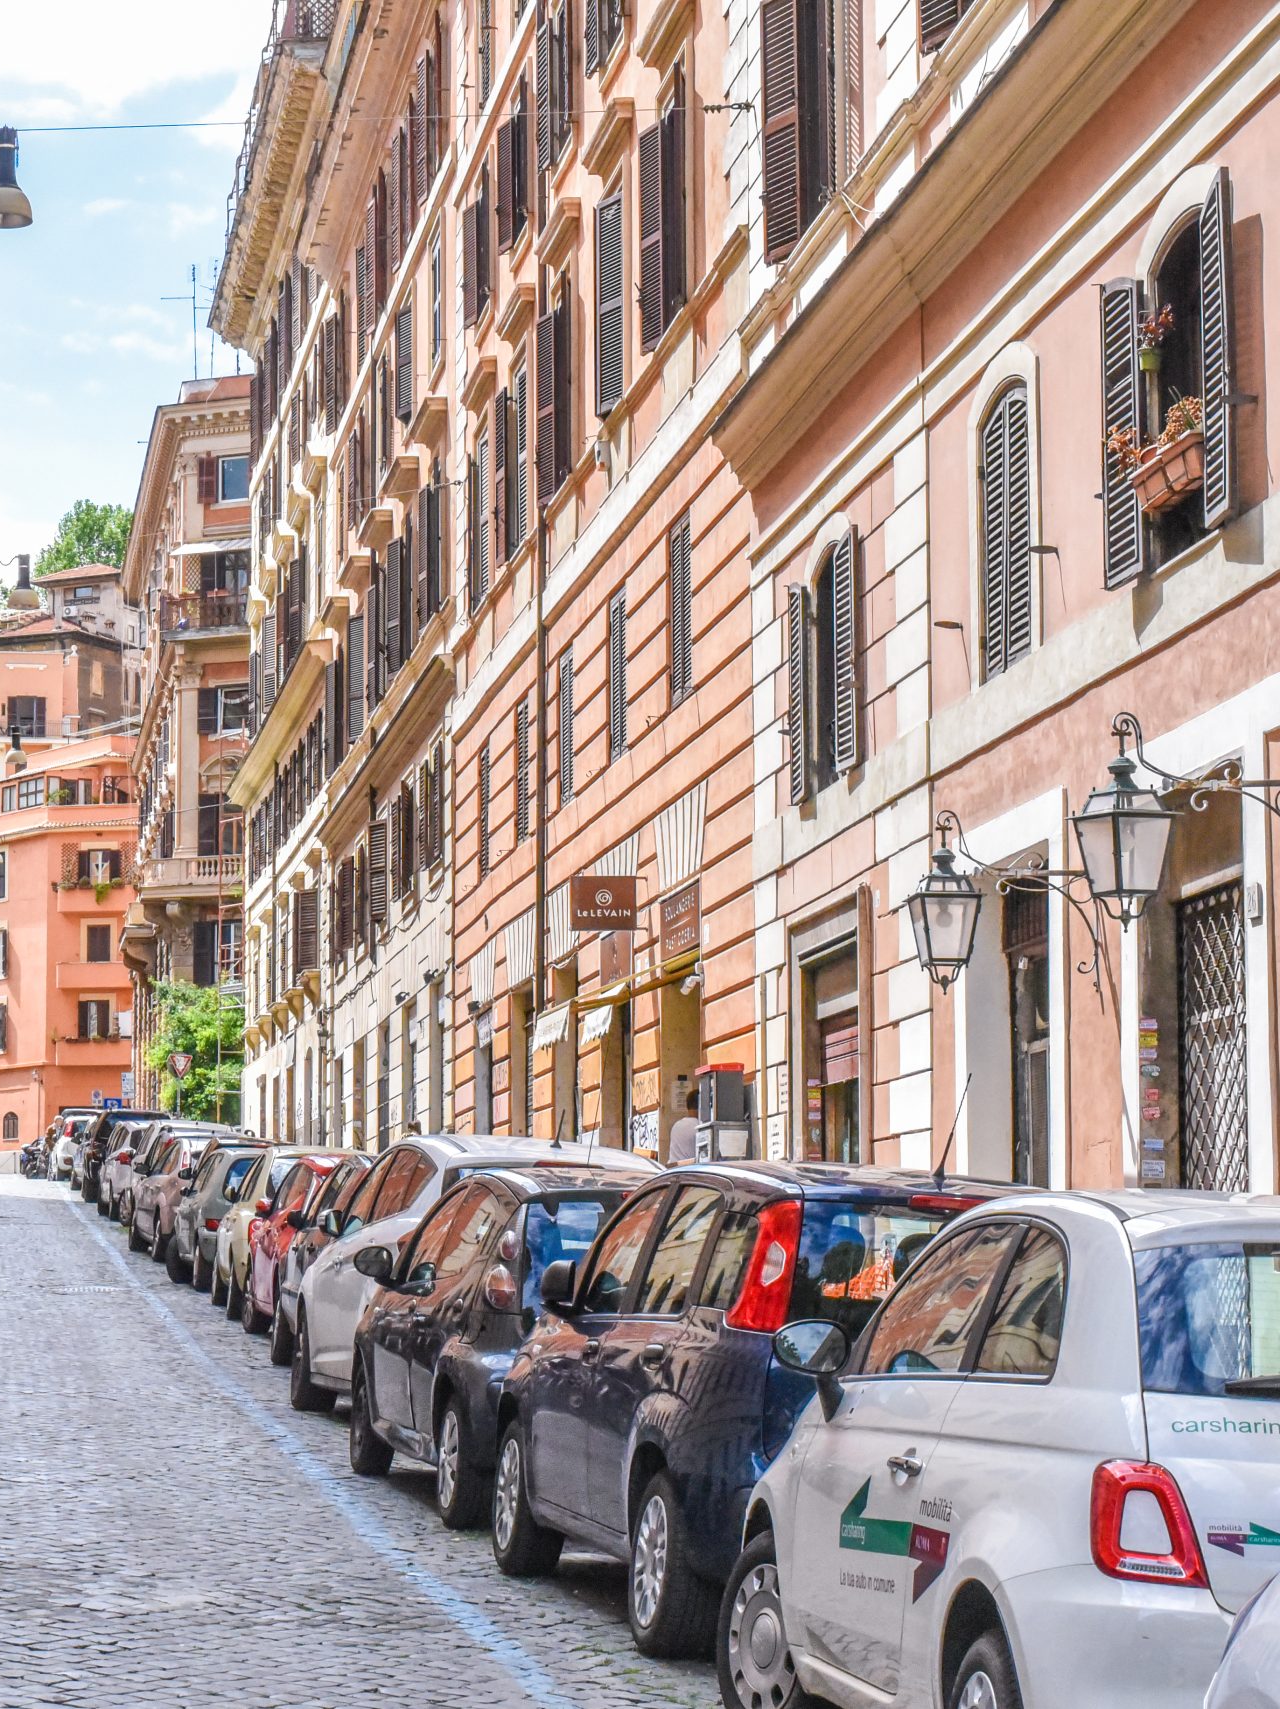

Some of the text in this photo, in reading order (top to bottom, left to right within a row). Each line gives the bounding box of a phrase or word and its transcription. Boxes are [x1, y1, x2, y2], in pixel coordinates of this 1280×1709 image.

[920, 1497, 952, 1522] mobilità
[842, 1521, 866, 1545] carsharing
[1209, 1524, 1243, 1532] mobilità
[873, 1577, 895, 1594] comune
